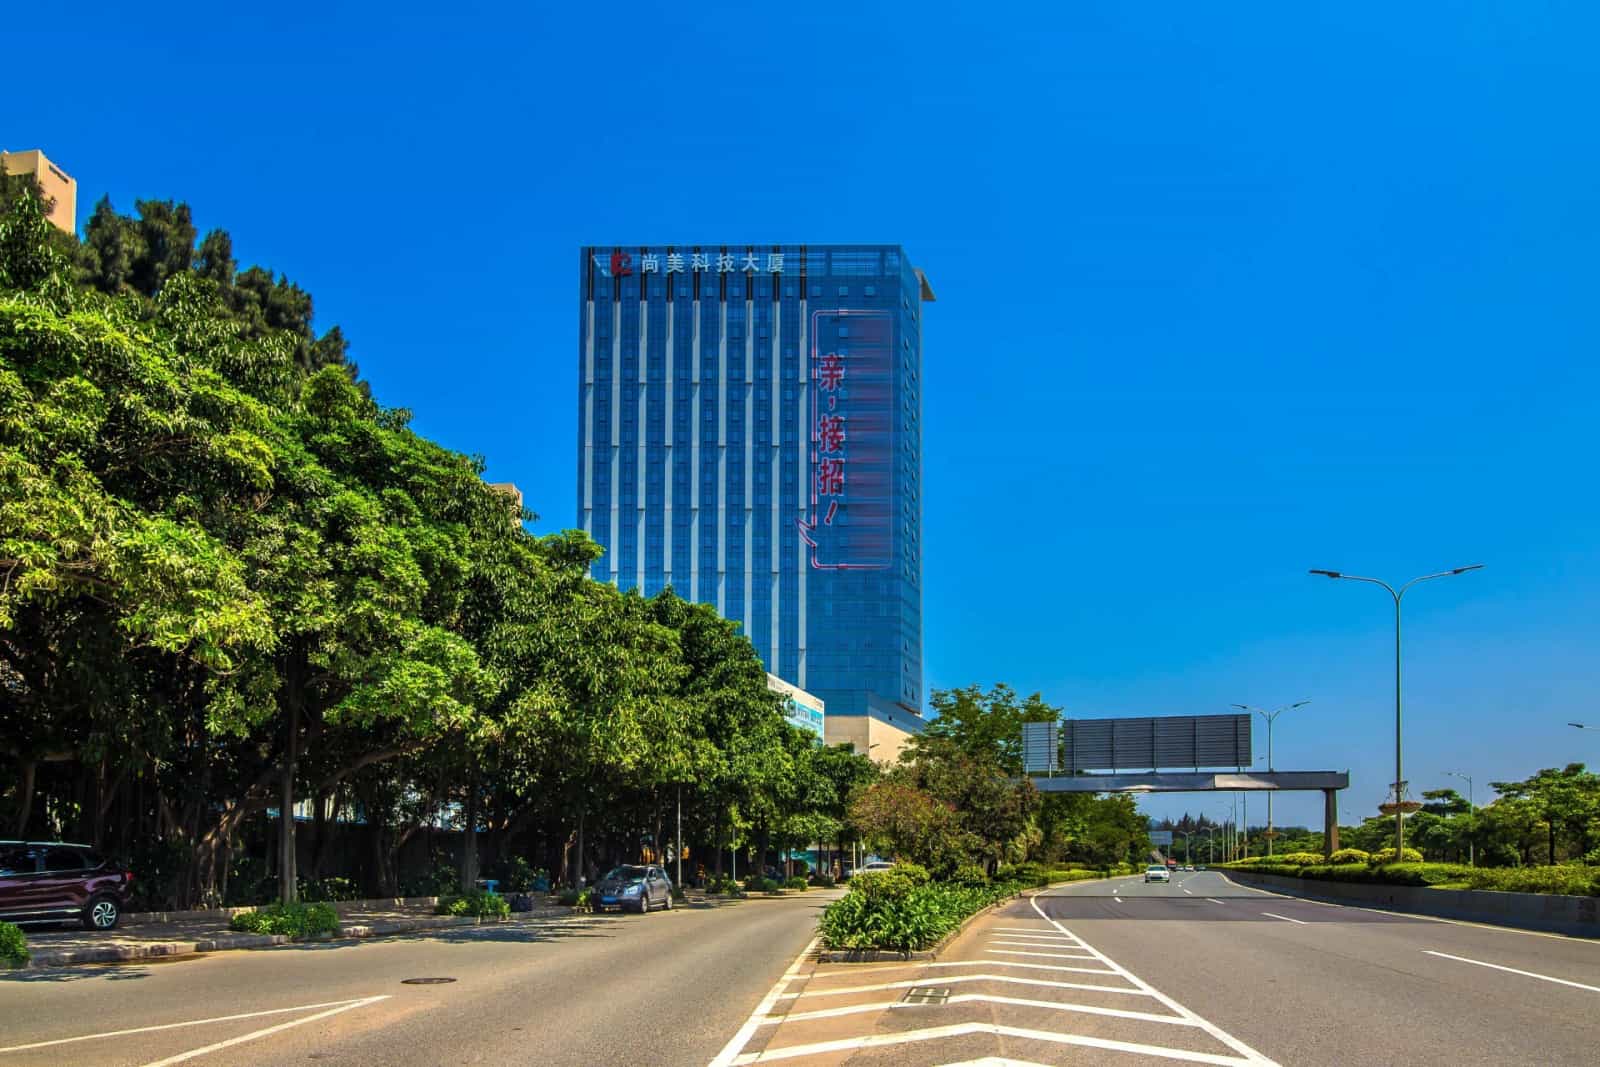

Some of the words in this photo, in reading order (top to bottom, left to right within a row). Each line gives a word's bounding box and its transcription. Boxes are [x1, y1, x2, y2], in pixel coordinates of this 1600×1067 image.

[642, 253, 785, 273] 尚美科技大厦
